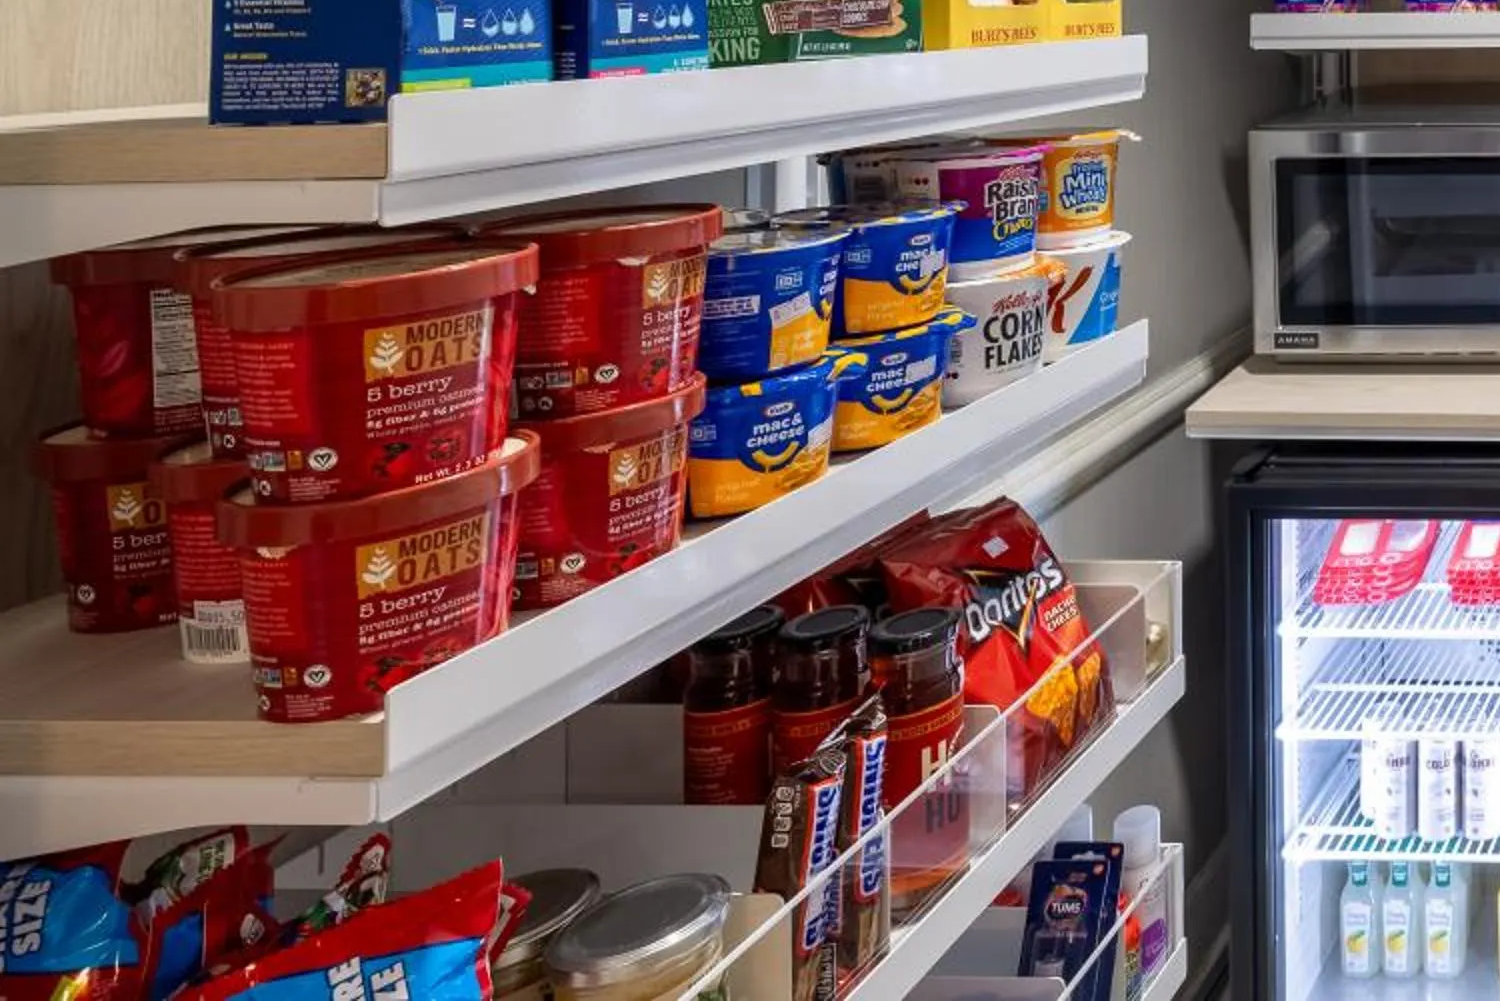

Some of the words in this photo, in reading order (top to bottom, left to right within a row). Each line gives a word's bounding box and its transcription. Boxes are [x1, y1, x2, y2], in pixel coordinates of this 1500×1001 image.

[971, 27, 1010, 44] BURT'S
[1011, 26, 1038, 41] BEES
[1063, 23, 1096, 36] BURT'S
[708, 37, 761, 63] KING
[1064, 172, 1106, 192] Mini
[994, 198, 1036, 222] Bran
[404, 311, 486, 345] MODERN
[983, 302, 1045, 344] CORN
[404, 332, 483, 373] OATS
[984, 334, 1043, 370] FLAKES
[387, 374, 454, 400] berry
[366, 399, 436, 420] premium
[415, 472, 434, 485] Net
[113, 535, 126, 550] 5
[129, 531, 168, 548] ber
[398, 517, 483, 558] MODERN
[397, 537, 482, 586] OATS
[358, 608, 429, 636] premium
[431, 590, 481, 616] oatmea
[380, 584, 448, 615] berry
[965, 557, 1064, 643] Doritos
[11, 877, 52, 957] SIZE
[1051, 901, 1081, 915] TUMS
